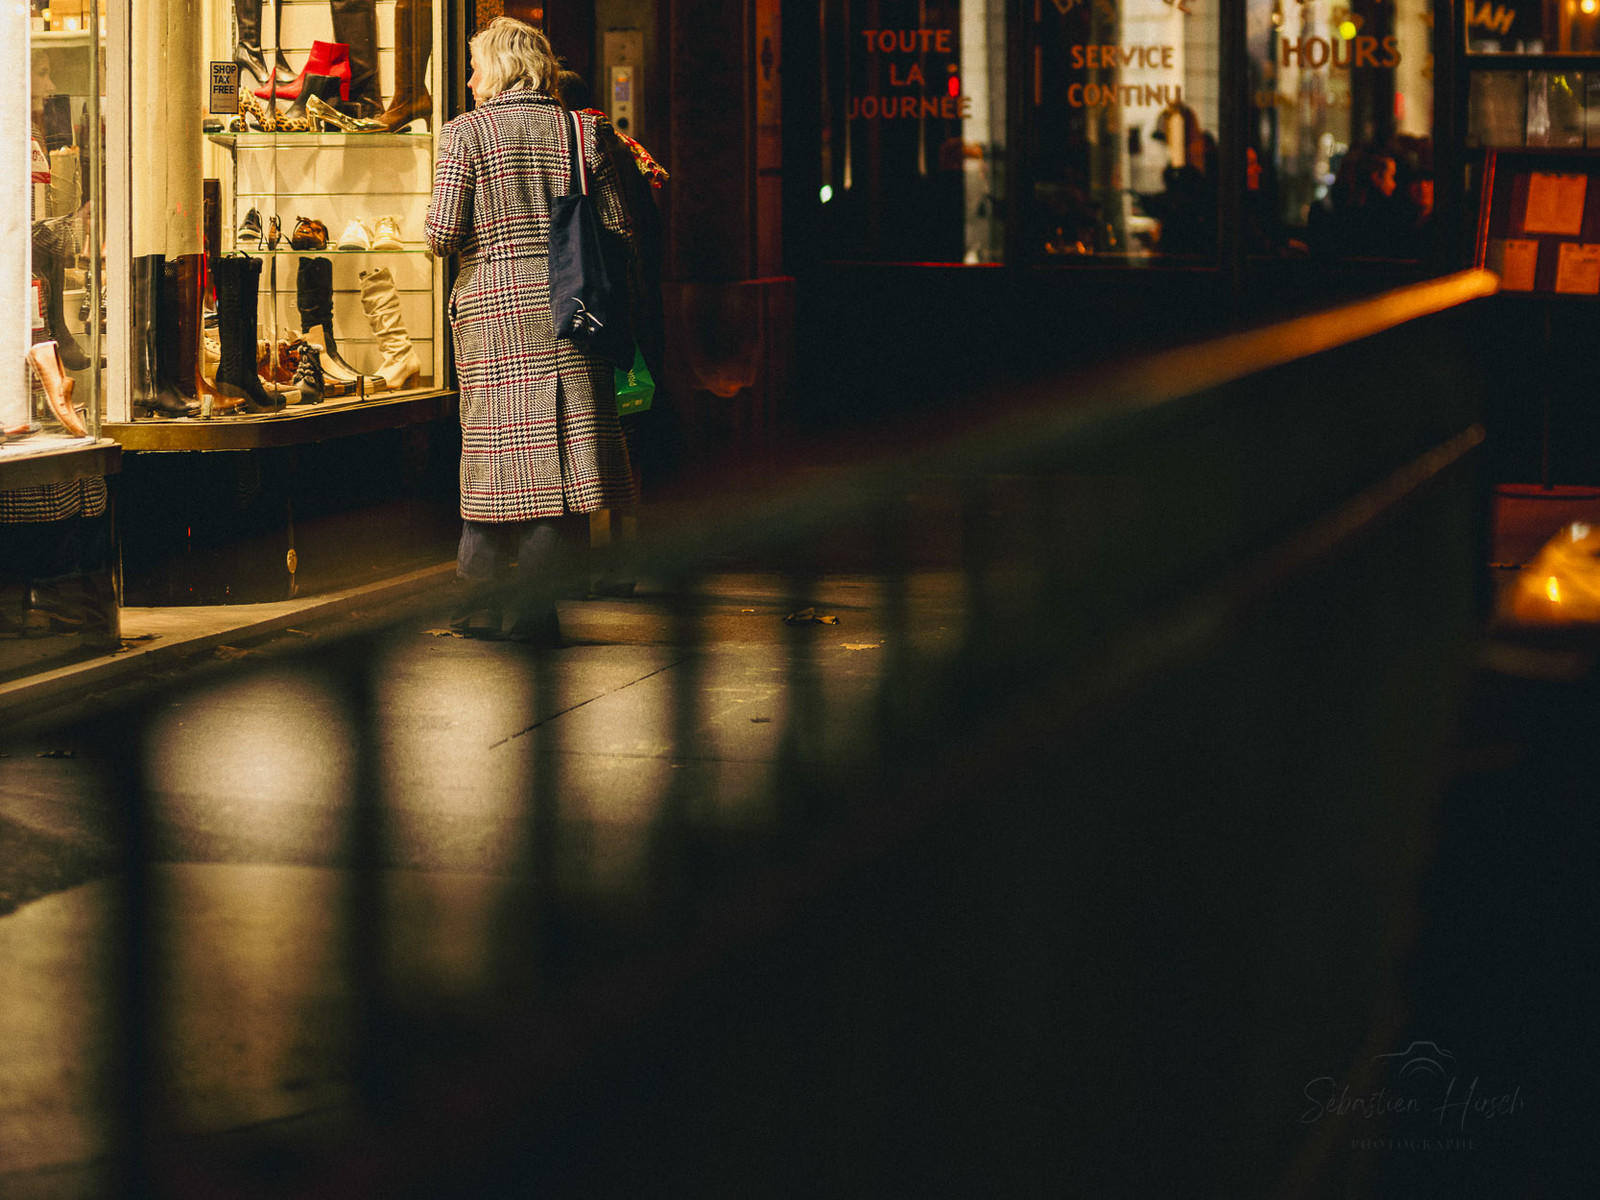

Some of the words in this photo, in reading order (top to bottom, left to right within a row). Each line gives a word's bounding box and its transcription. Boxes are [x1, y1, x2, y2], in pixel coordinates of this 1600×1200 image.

[862, 29, 953, 54] TOUTE
[1282, 36, 1401, 68] HOURS
[1070, 44, 1174, 69] SERVICE
[213, 65, 237, 74] SHOP
[213, 75, 230, 84] TAX
[889, 62, 926, 87] LA
[213, 85, 235, 94] FREE
[1067, 82, 1182, 108] CONTINU
